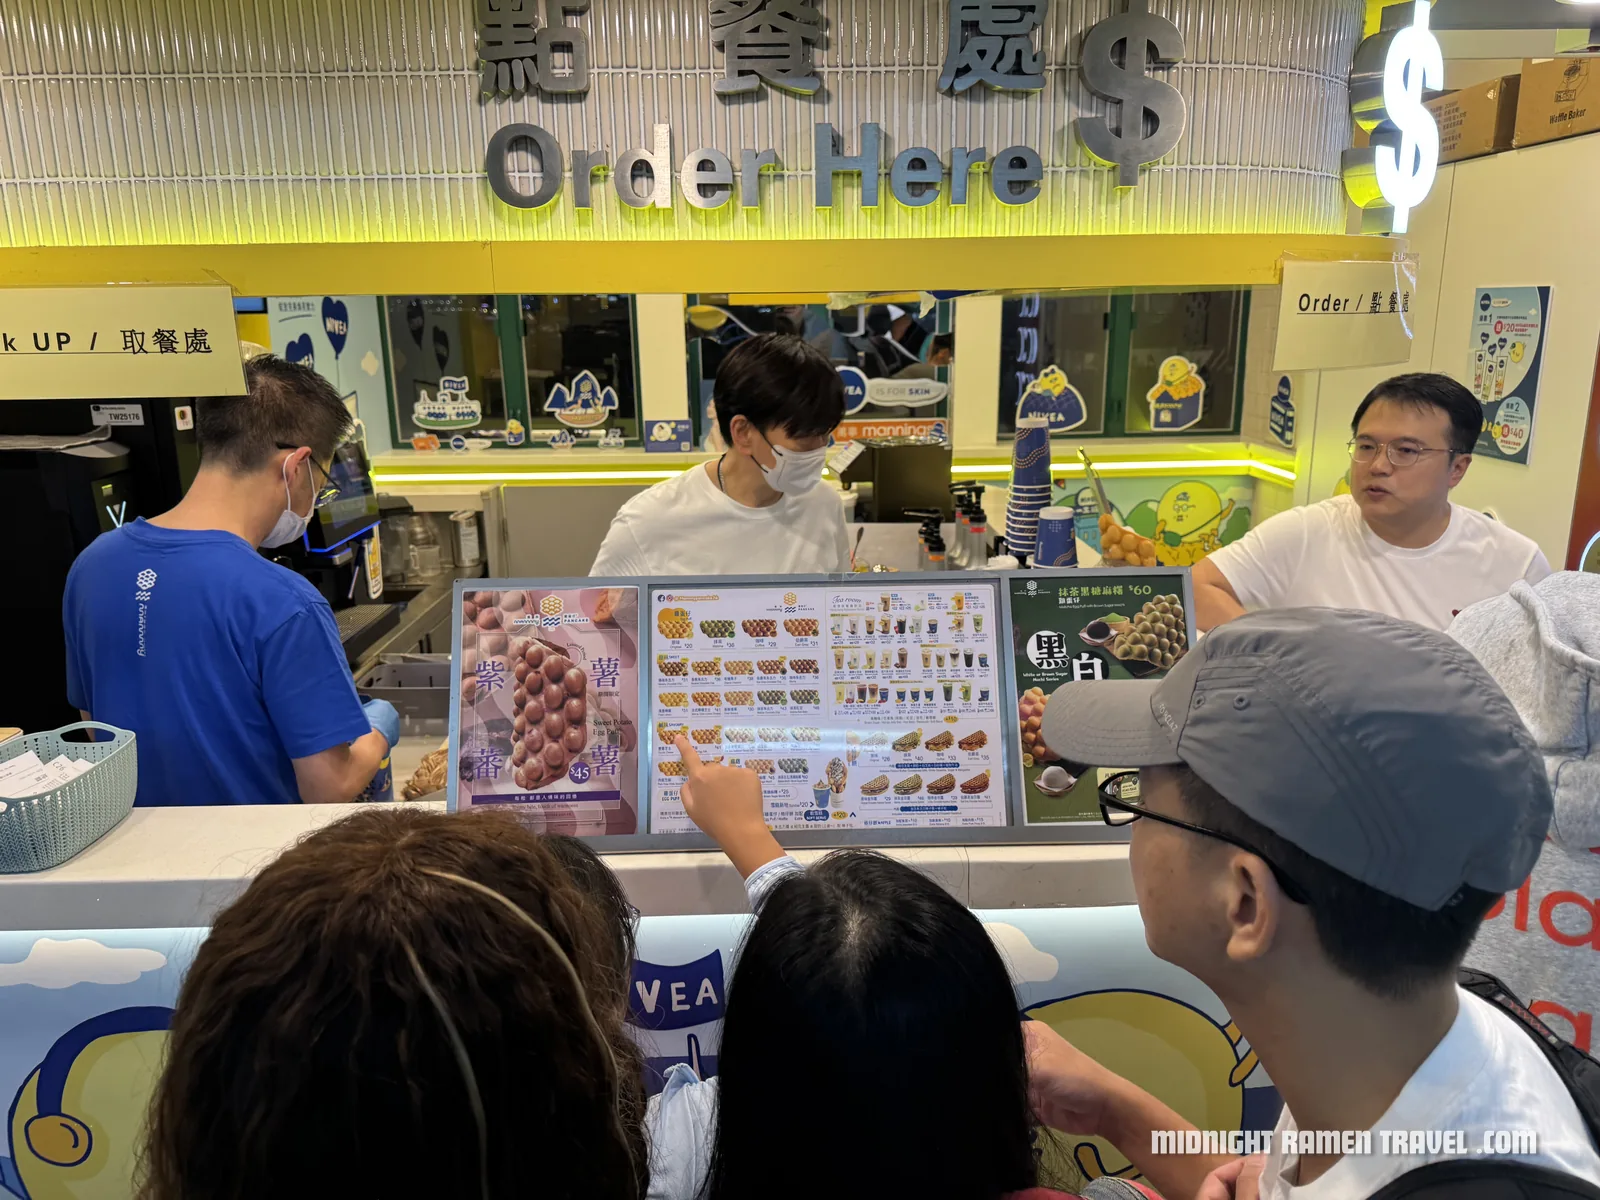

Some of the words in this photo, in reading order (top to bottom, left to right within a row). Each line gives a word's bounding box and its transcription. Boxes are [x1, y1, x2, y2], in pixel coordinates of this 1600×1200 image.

[1550, 111, 1567, 124] Waffle
[1569, 108, 1586, 119] Baker
[486, 122, 776, 211] Order
[815, 122, 1043, 208] Here
[1298, 293, 1350, 312] Order
[1355, 293, 1363, 312] /
[34, 332, 71, 351] UP
[120, 328, 213, 355] 取餐處
[908, 387, 930, 395] SKIN
[1129, 584, 1152, 596] $60
[1036, 632, 1070, 669] 黑
[475, 660, 505, 692] 紫
[593, 729, 605, 737] Egg
[570, 767, 590, 780] $45
